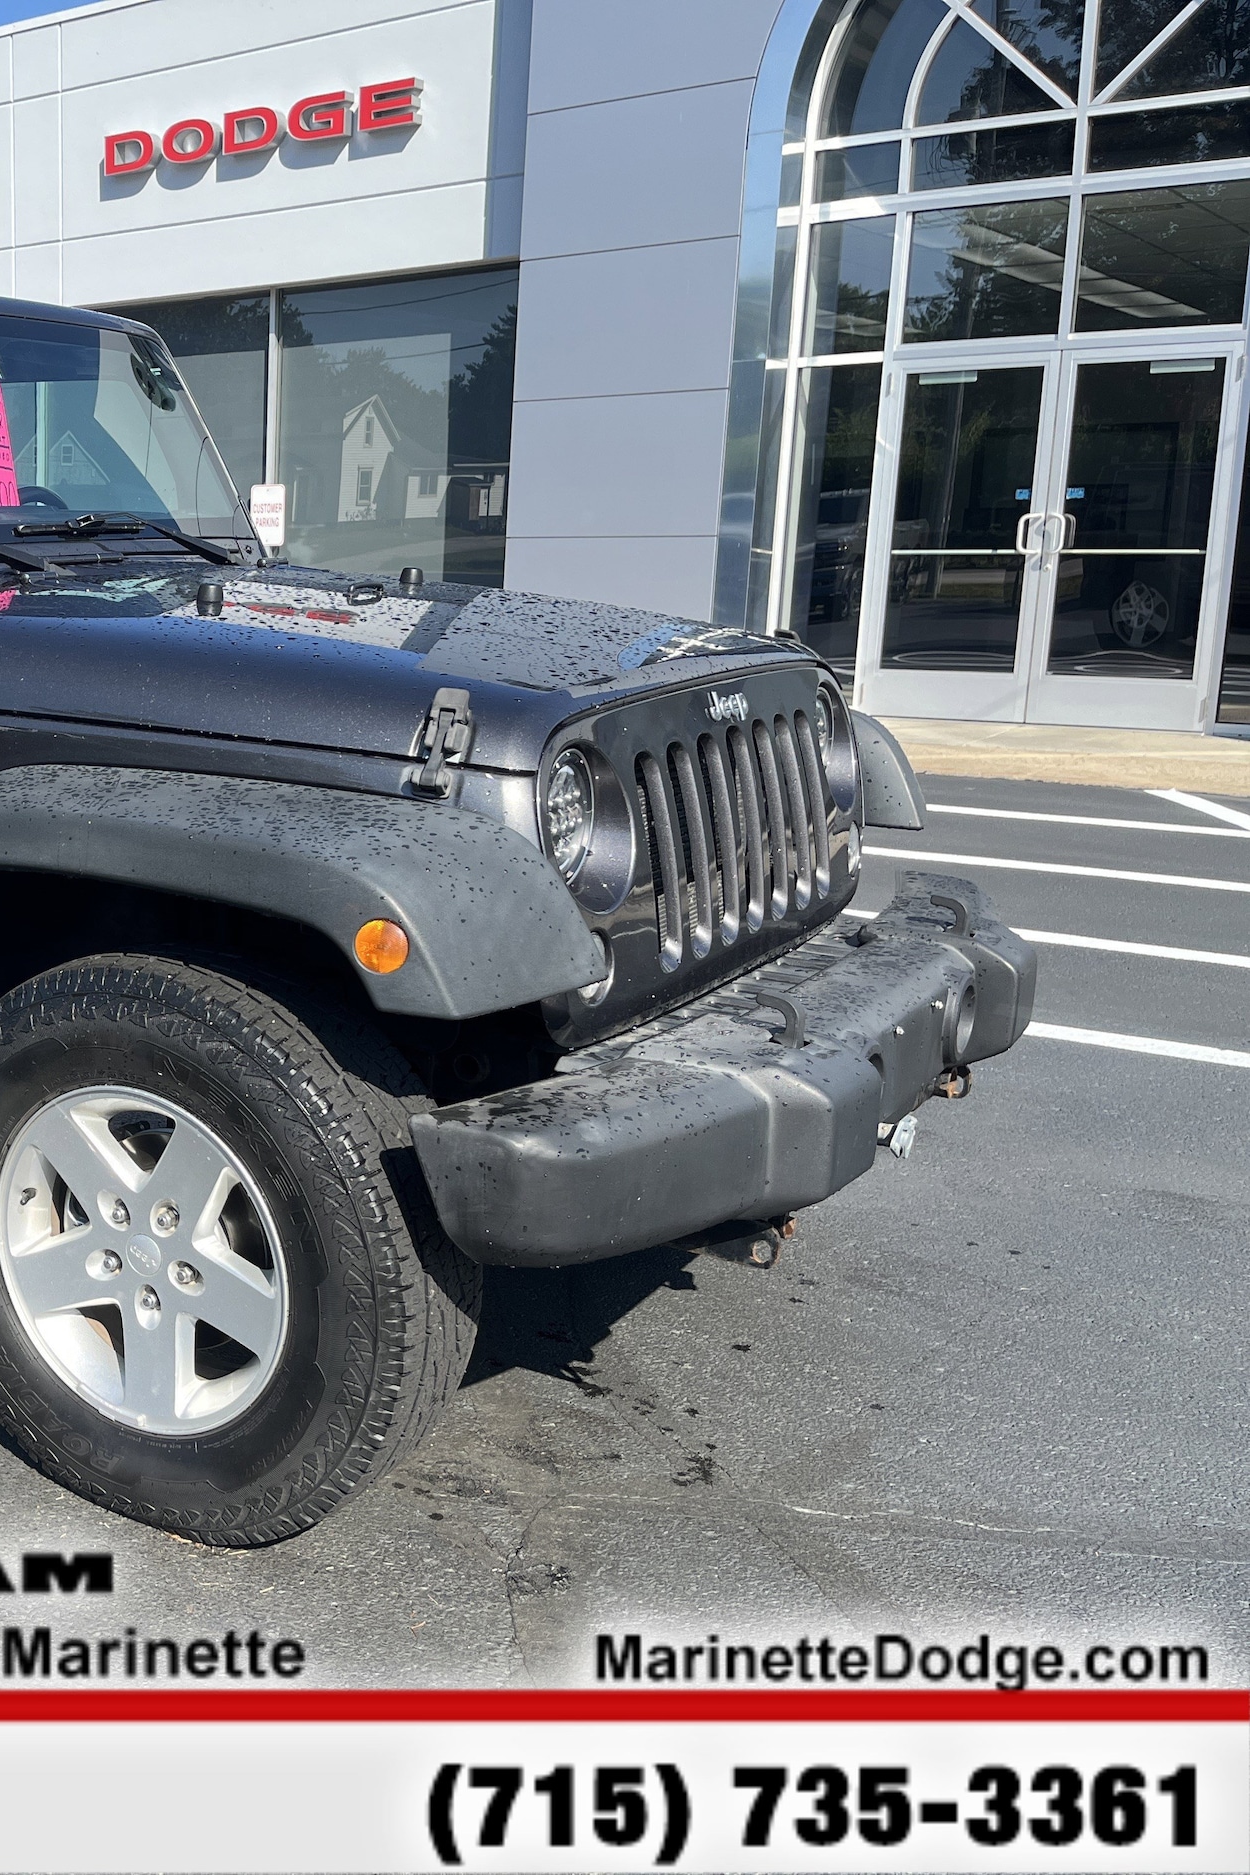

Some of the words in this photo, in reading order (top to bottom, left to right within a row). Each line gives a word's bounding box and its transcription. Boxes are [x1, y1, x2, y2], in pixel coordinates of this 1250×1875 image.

[103, 77, 425, 176] DODGE
[253, 503, 283, 514] CUSTOMER
[255, 517, 280, 527] PARKING
[705, 691, 749, 723] Jeep
[151, 1048, 321, 1256] NEXEN
